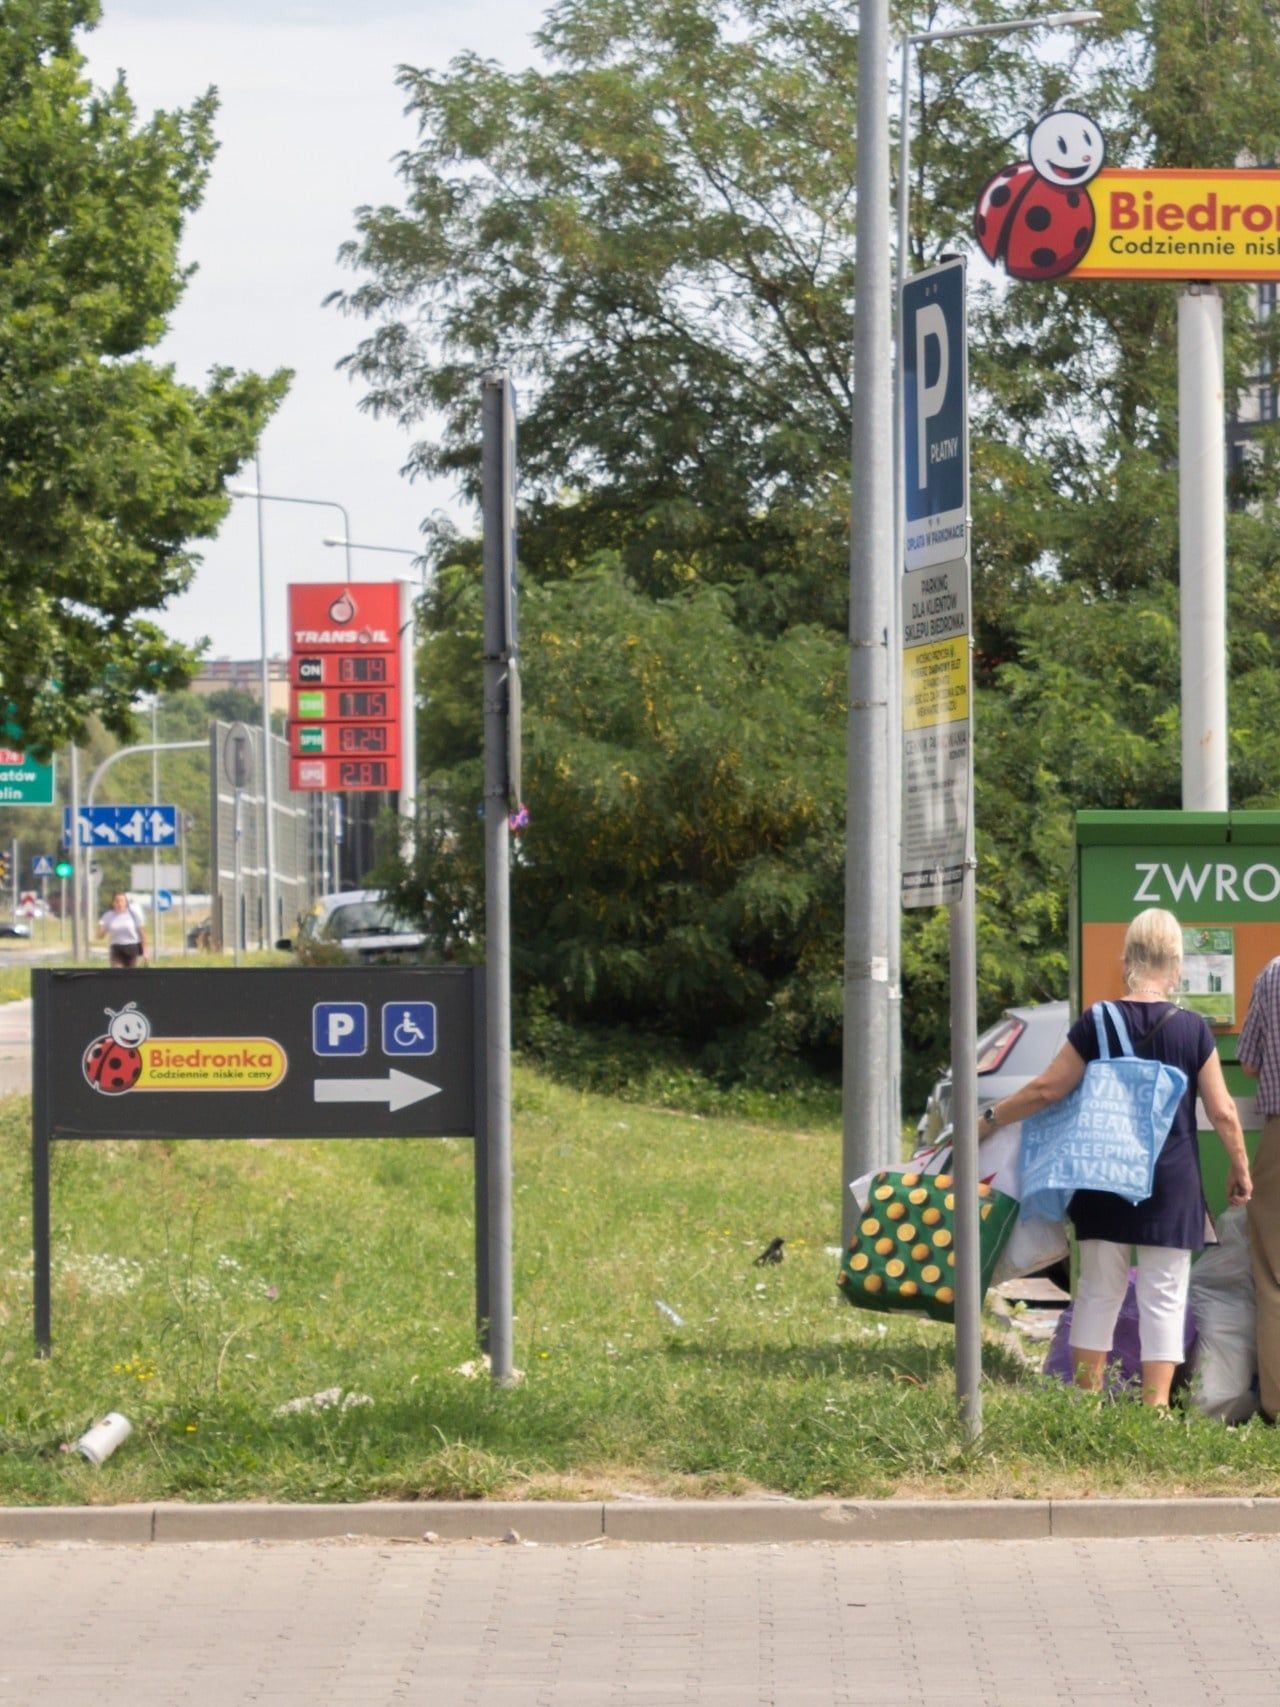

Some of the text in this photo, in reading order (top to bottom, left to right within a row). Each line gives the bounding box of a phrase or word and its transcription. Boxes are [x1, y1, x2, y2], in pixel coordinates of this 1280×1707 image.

[1109, 235, 1236, 256] Codziennie
[916, 303, 949, 490] P
[931, 437, 958, 464] PŁATNY
[921, 574, 948, 594] PARKING
[912, 601, 925, 619] DLA
[930, 612, 965, 636] BIEDRONKA
[301, 664, 321, 676] ON
[328, 1013, 354, 1046] P
[150, 1049, 273, 1068] Biedronka
[149, 1069, 273, 1081] Codziennie niskie ceny
[1060, 1142, 1150, 1166] SLEEPING
[1057, 1158, 1149, 1185] LIVING
